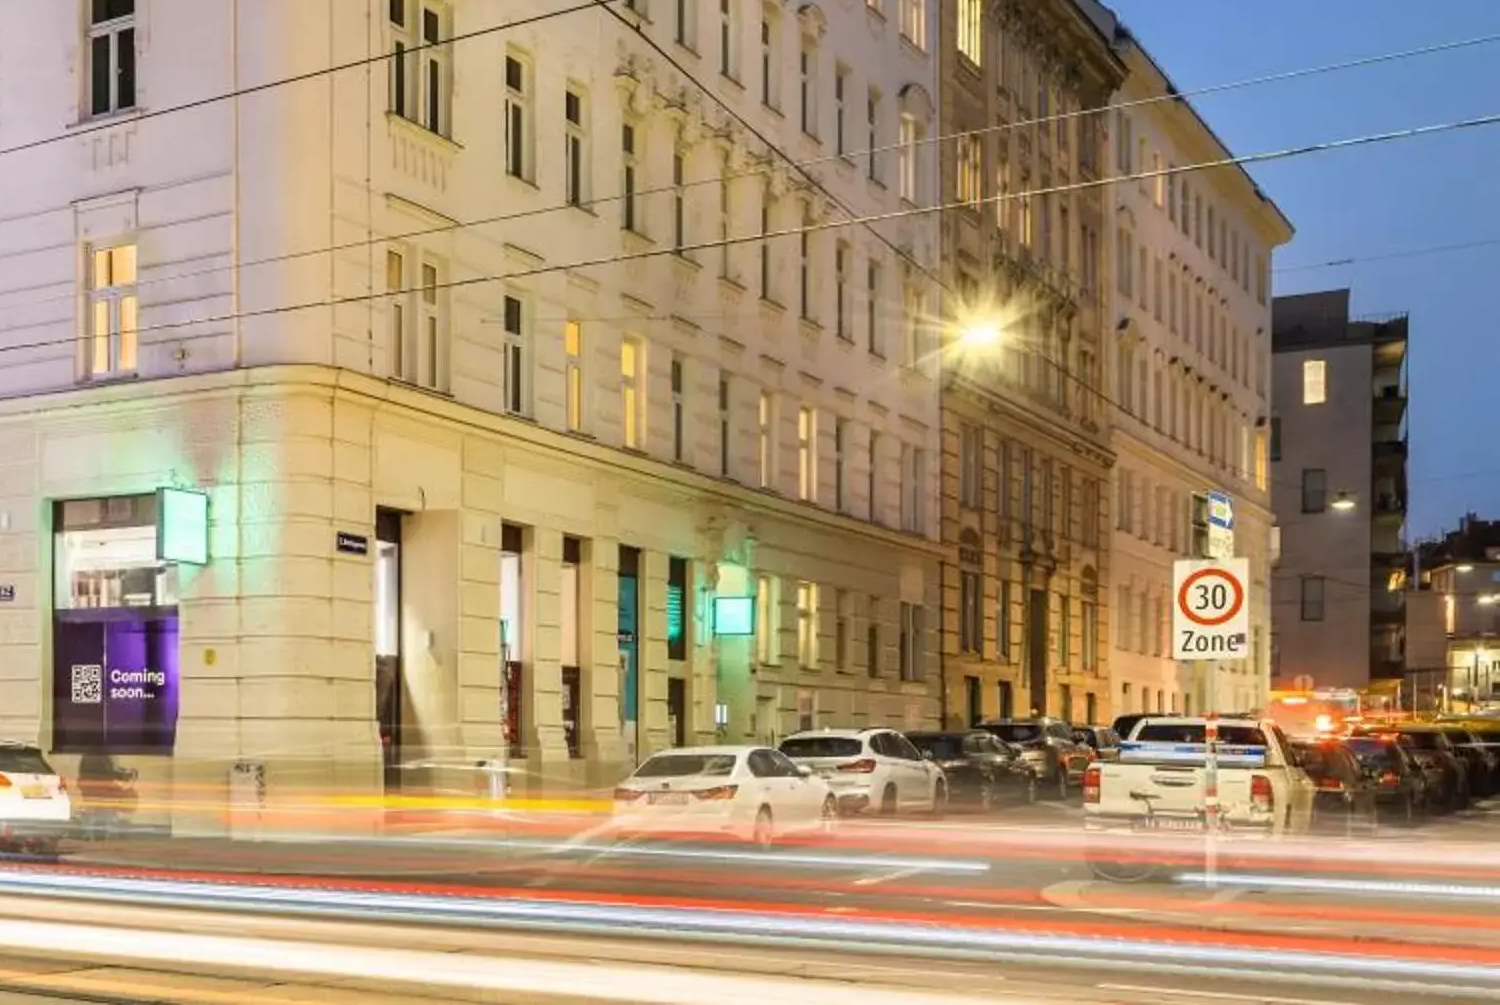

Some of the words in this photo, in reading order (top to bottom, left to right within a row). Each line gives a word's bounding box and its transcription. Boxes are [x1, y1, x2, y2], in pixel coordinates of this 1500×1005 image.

[1195, 584, 1227, 610] 30
[1181, 630, 1239, 652] Zone
[110, 669, 165, 686] Coming
[110, 687, 155, 699] soon...
